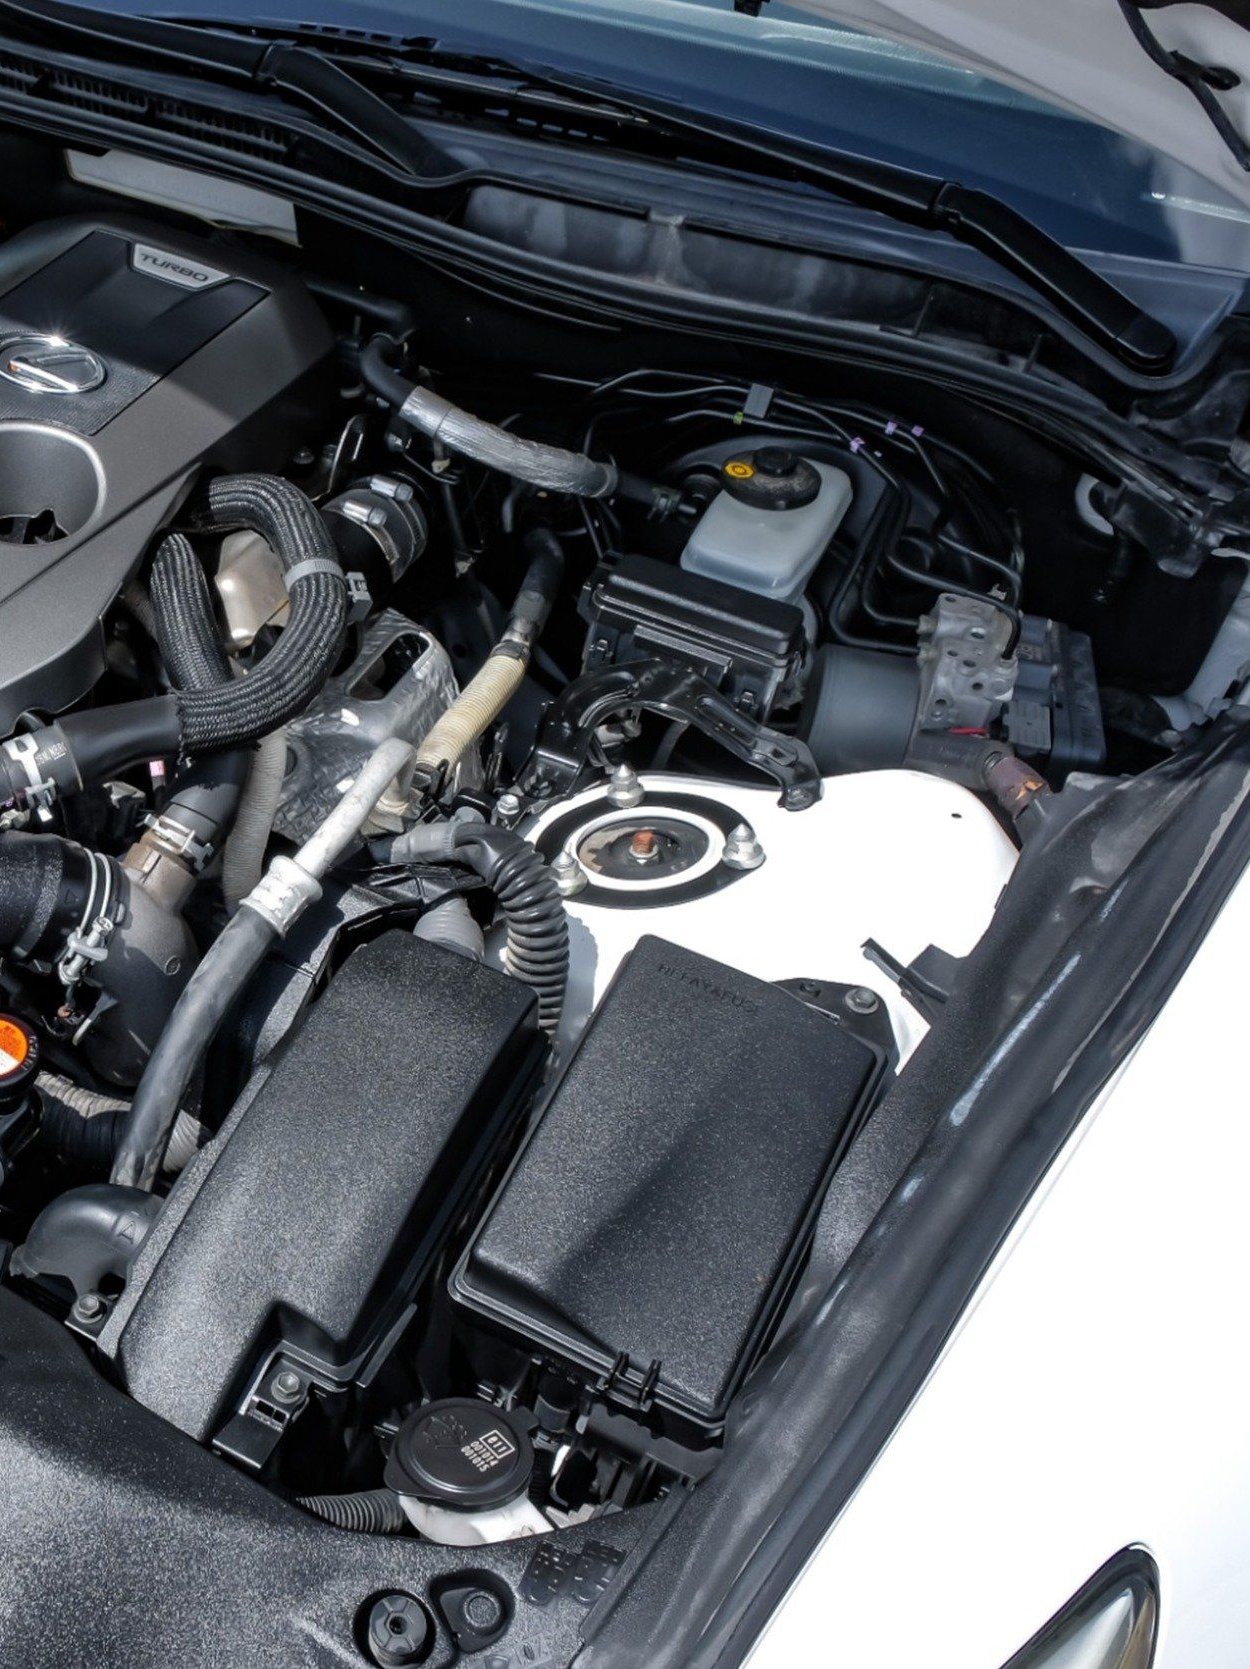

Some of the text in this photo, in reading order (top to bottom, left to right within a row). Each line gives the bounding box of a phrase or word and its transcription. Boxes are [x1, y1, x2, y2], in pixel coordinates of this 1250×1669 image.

[141, 254, 209, 282] TURBO
[487, 1436, 508, 1453] e11
[460, 1445, 490, 1473] 001015
